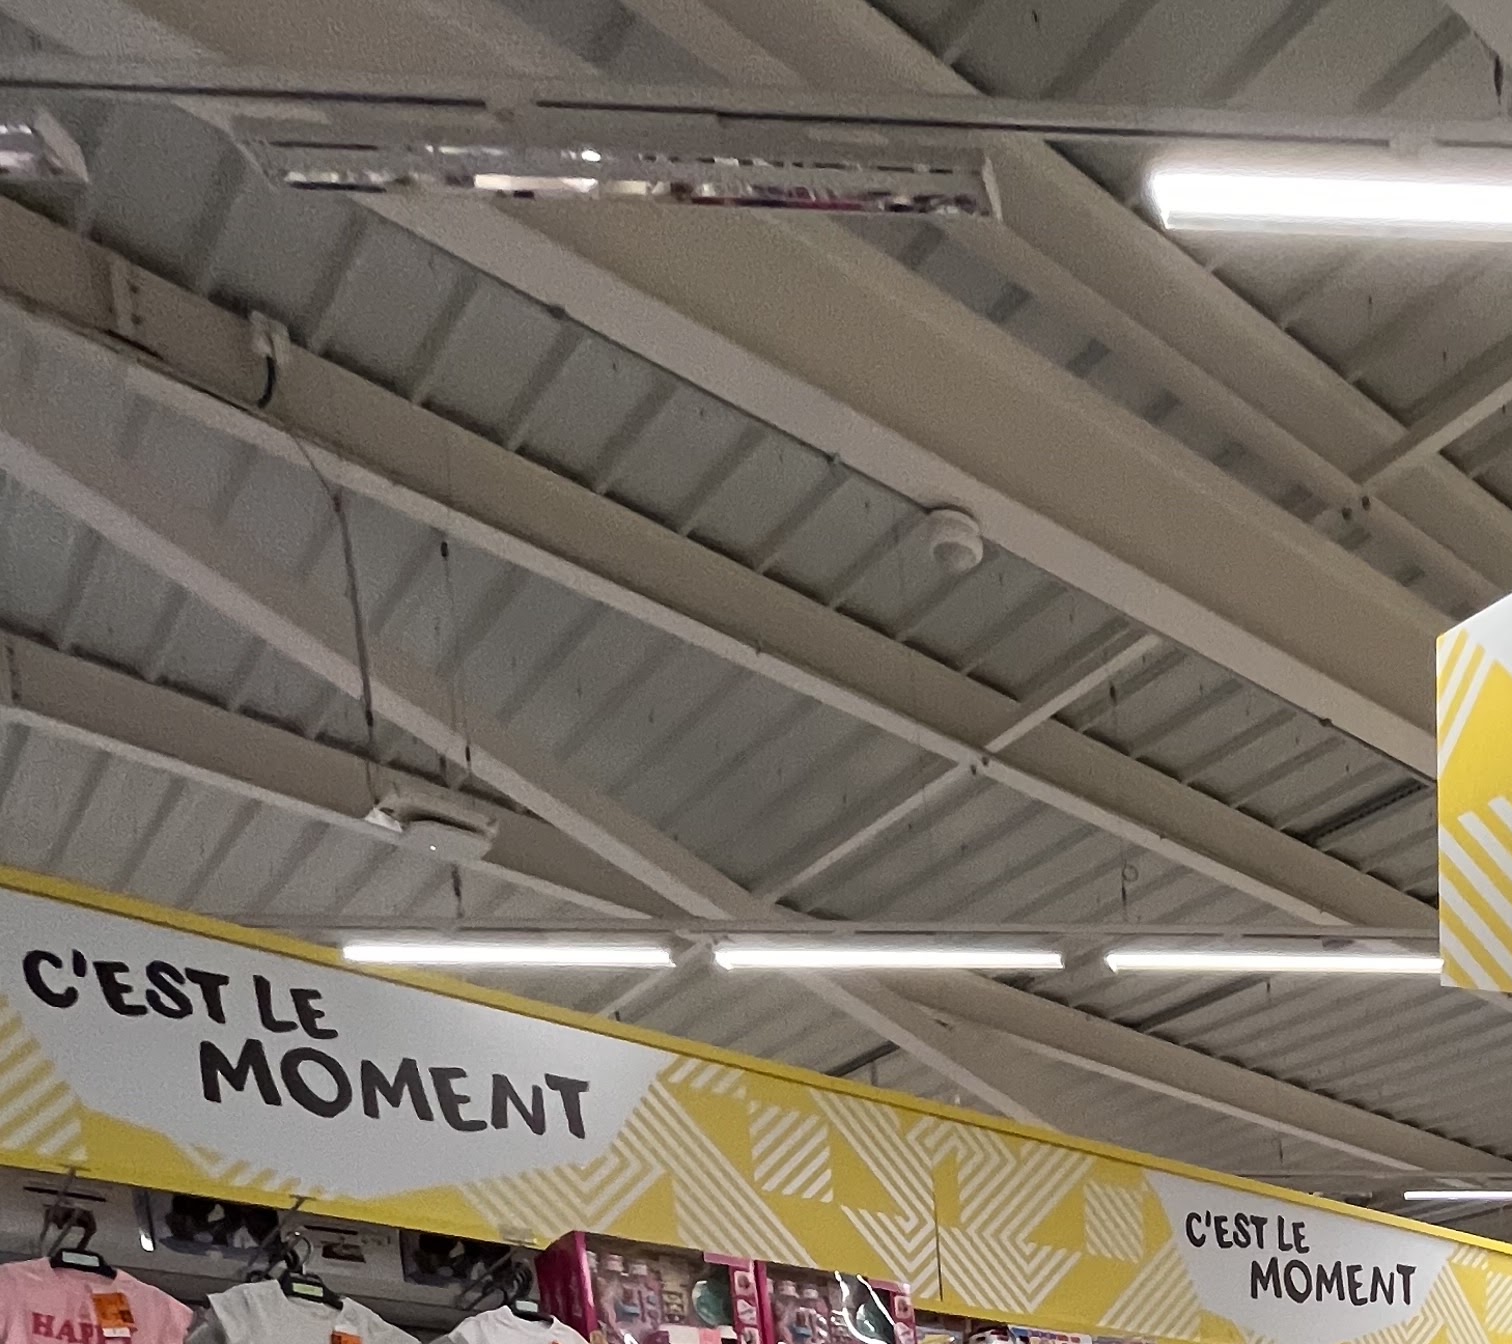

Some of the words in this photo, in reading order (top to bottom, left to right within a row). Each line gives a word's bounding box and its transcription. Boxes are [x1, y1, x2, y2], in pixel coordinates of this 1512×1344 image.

[24, 948, 230, 1026] C'EST
[254, 975, 338, 1040] LE
[200, 1039, 590, 1140] MOMENT
[1185, 1211, 1266, 1253] C'EST
[1277, 1221, 1310, 1255] LE
[1250, 1257, 1417, 1306] MOMENT
